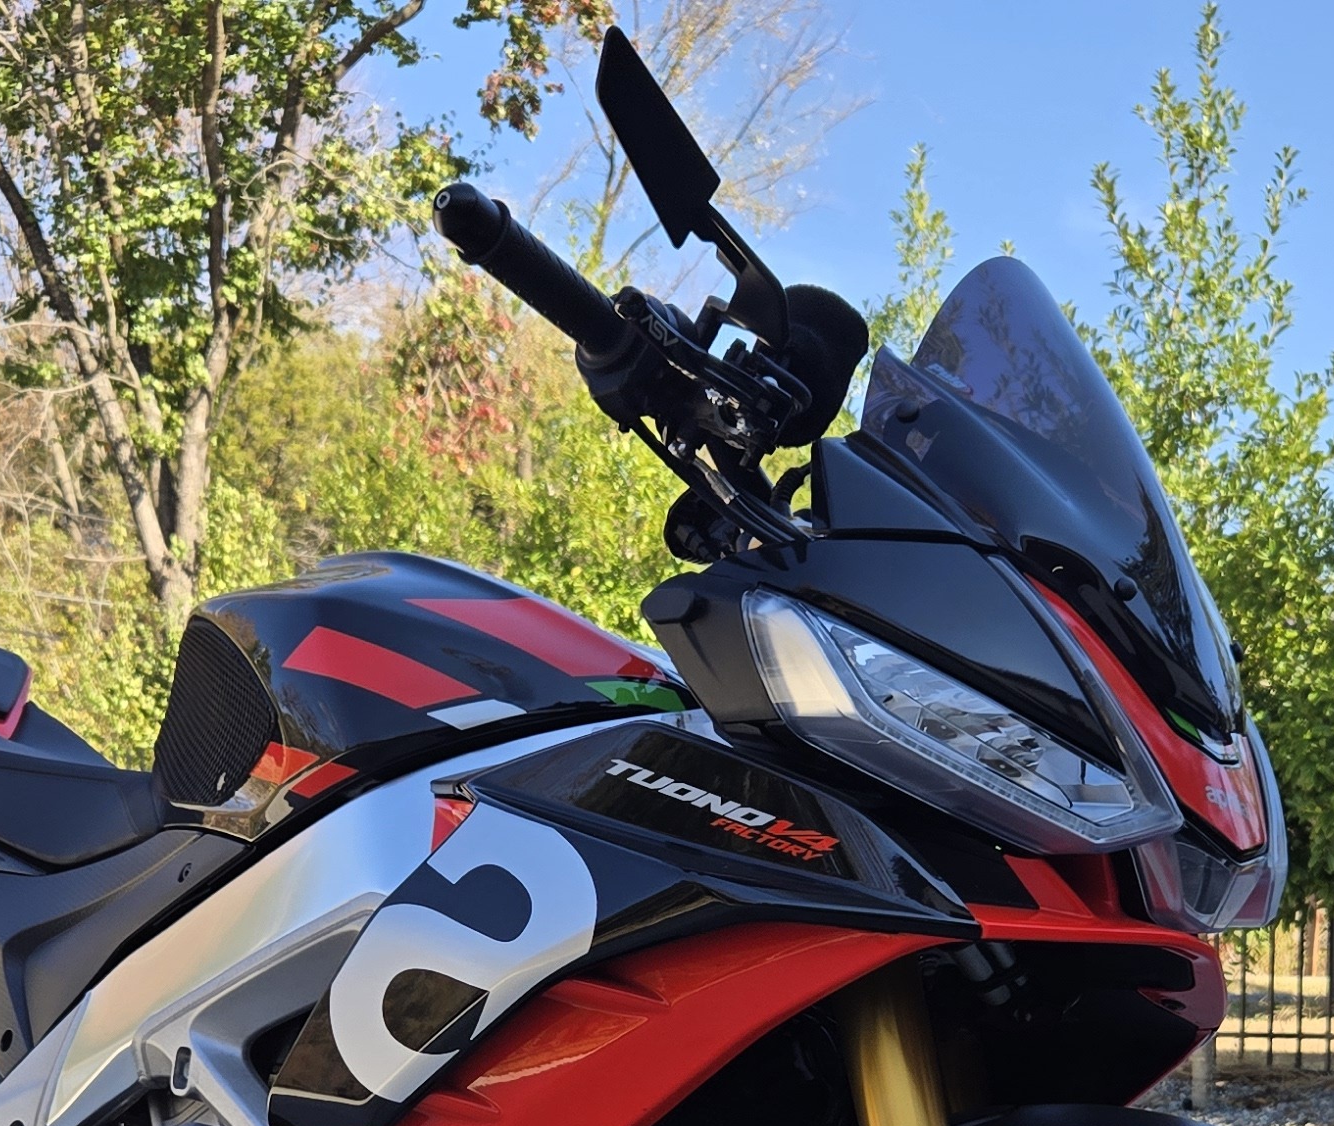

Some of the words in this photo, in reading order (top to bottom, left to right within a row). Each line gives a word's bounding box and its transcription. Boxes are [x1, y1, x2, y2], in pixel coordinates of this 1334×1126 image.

[640, 314, 679, 347] ASV
[605, 759, 777, 827] TUONO
[765, 820, 840, 852] V4
[710, 817, 824, 862] FACTORY
